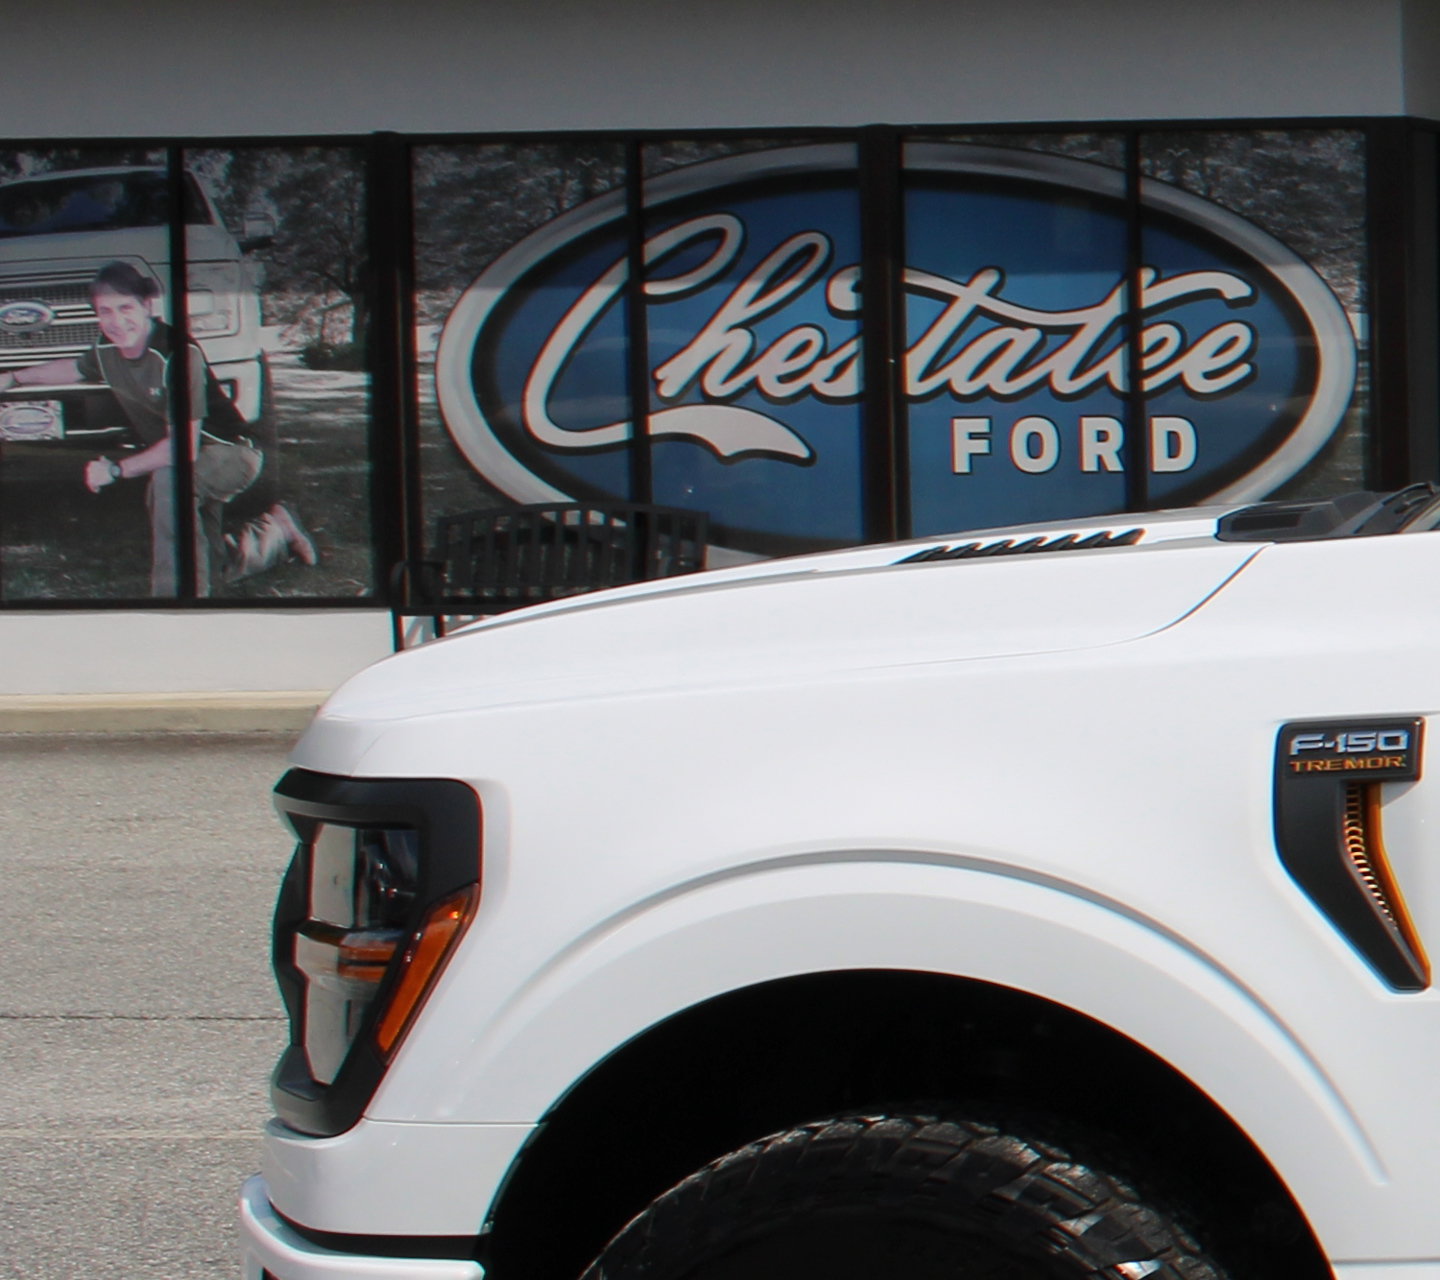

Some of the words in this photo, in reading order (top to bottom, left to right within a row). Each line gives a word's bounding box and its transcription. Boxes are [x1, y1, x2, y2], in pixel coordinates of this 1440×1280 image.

[522, 210, 1257, 464] Chestatee
[951, 415, 1199, 474] FORD
[1289, 729, 1410, 757] F-150
[1289, 754, 1406, 773] TREMOR
